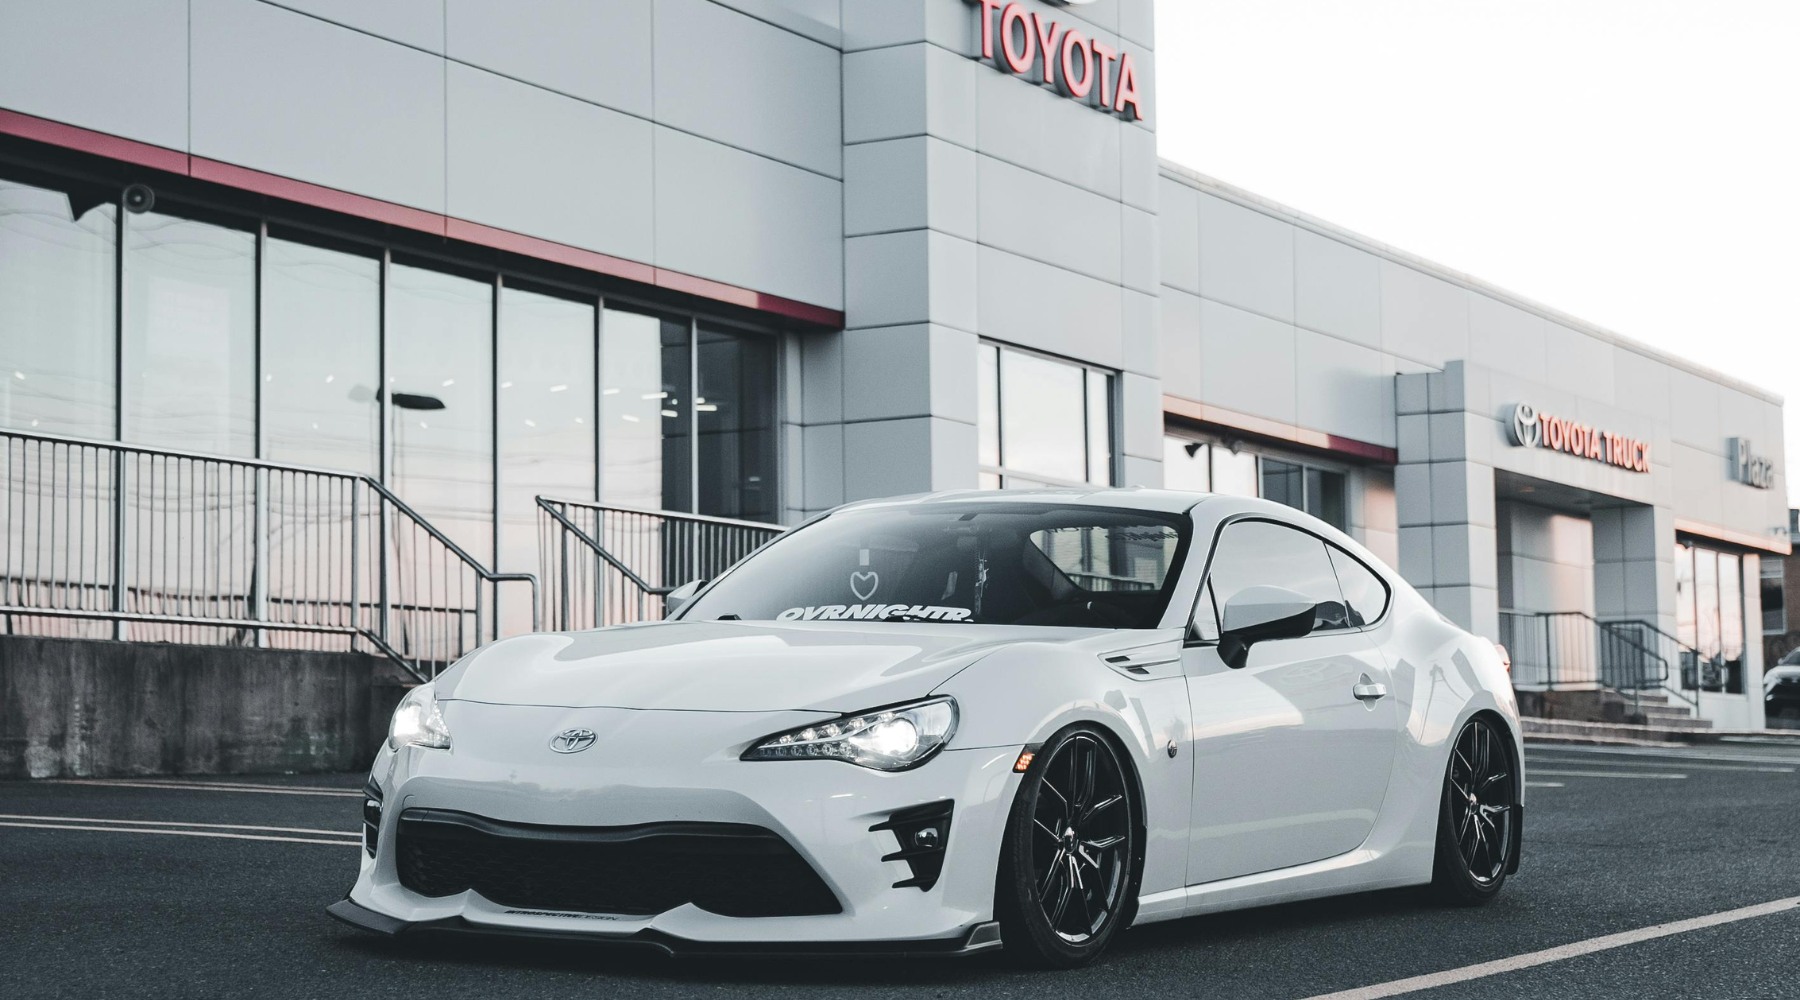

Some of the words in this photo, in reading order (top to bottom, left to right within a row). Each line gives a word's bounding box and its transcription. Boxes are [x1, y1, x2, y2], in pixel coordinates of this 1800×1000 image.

[977, 0, 1143, 121] TOYOTA
[1538, 413, 1602, 460] TOYOTA
[1602, 431, 1651, 473] TRUCK
[1735, 437, 1773, 490] Plaza
